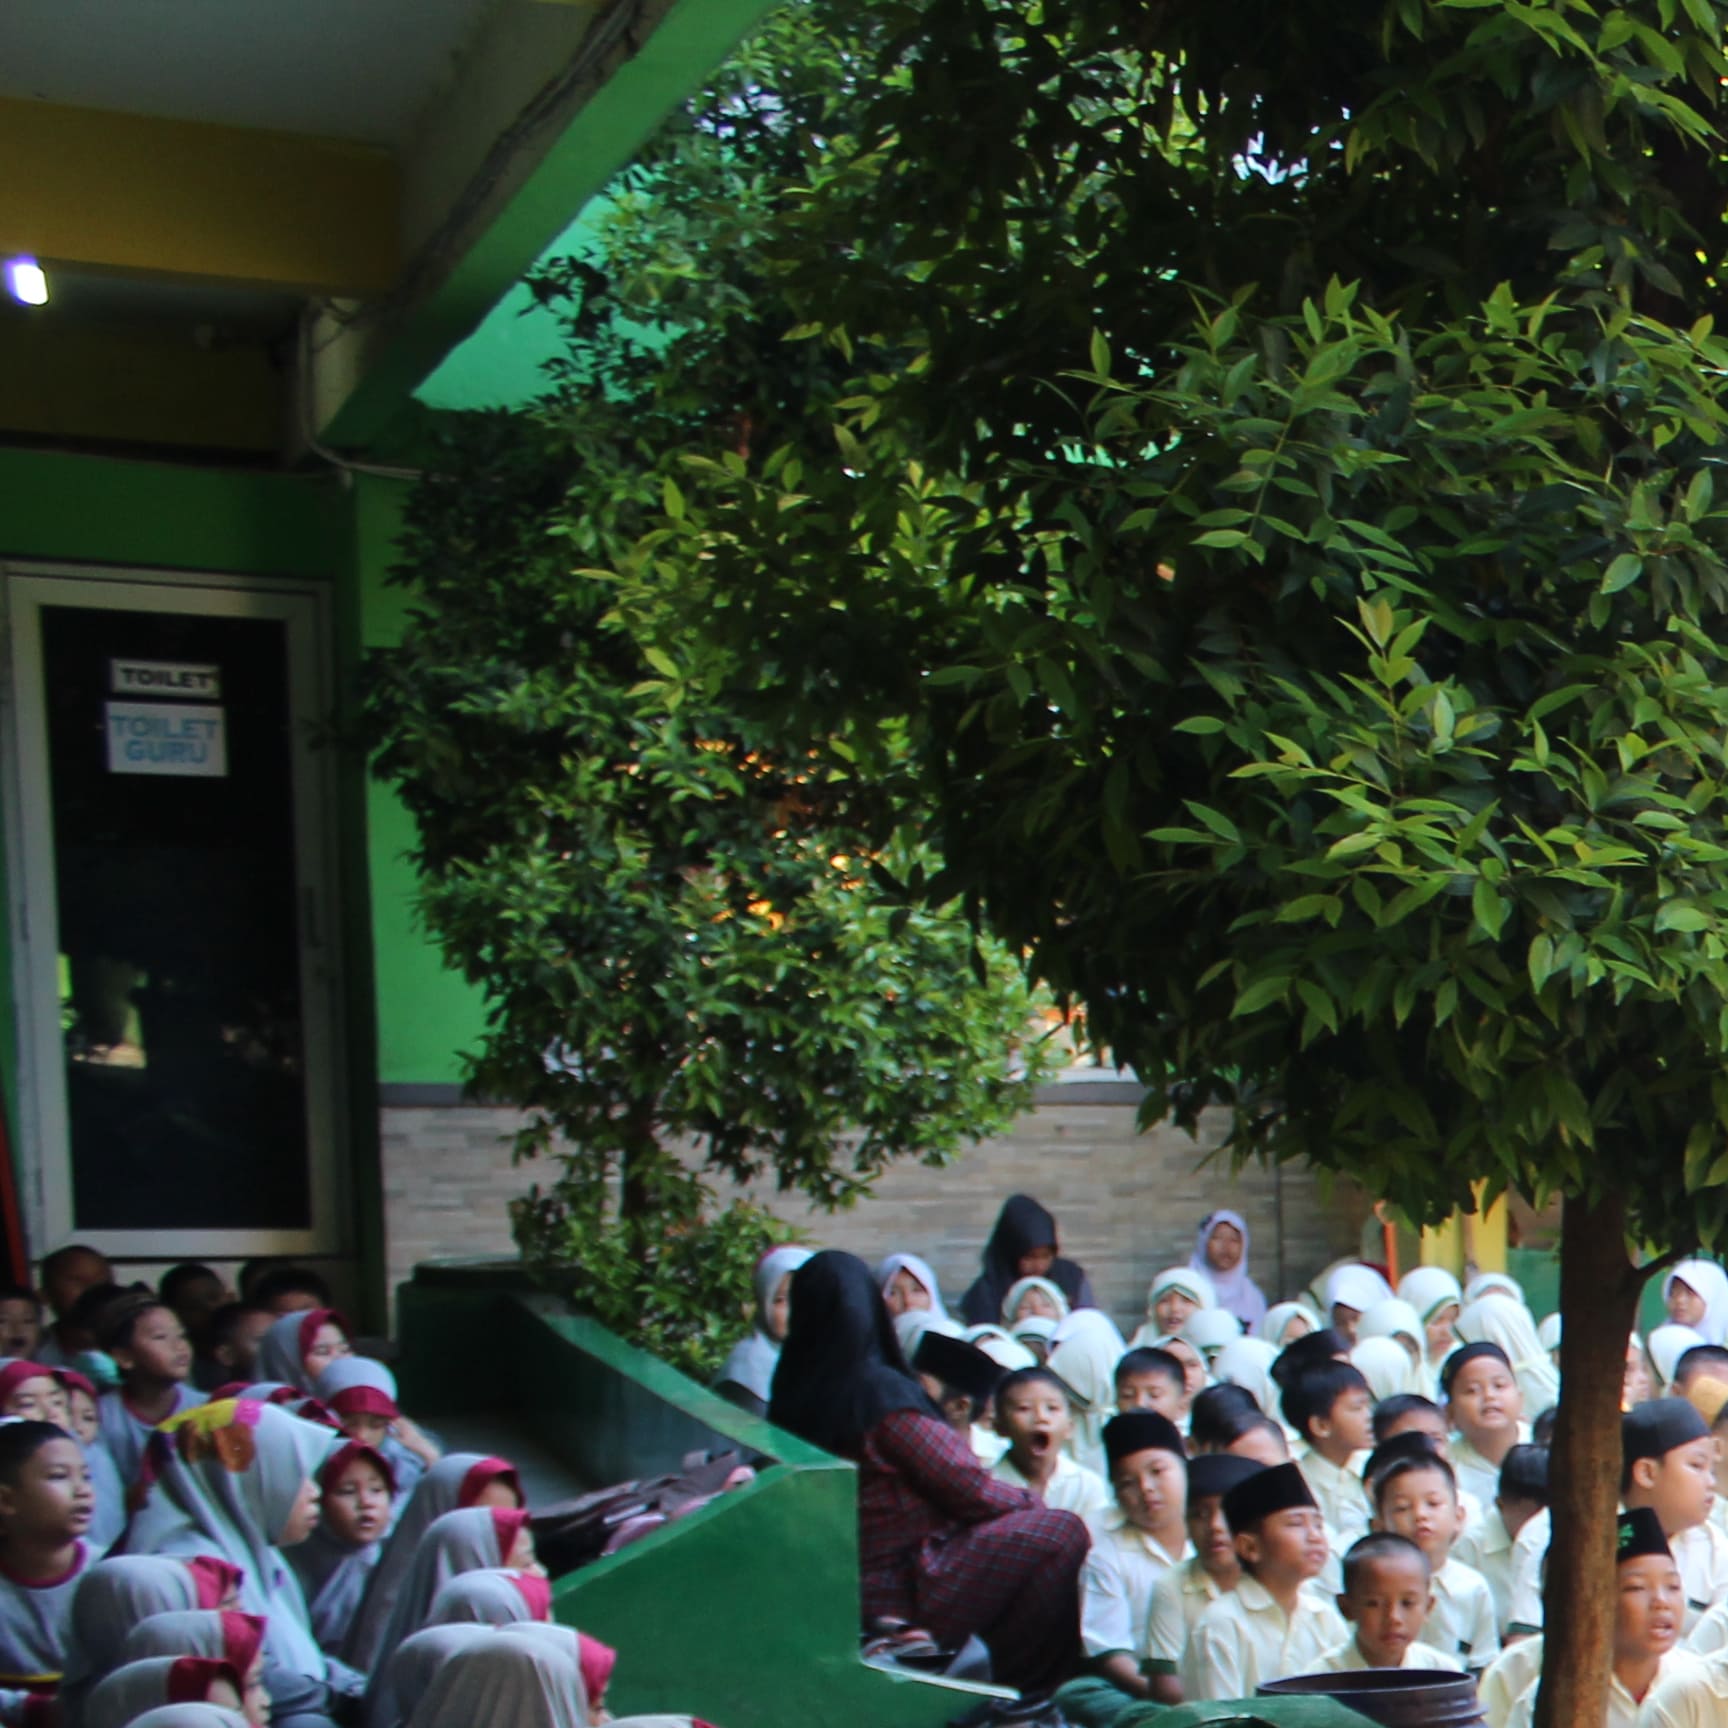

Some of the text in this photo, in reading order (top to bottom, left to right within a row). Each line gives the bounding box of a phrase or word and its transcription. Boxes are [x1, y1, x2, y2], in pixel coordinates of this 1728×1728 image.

[120, 667, 212, 689] TOILET
[110, 714, 218, 738] TOILET
[125, 739, 208, 763] GURU
